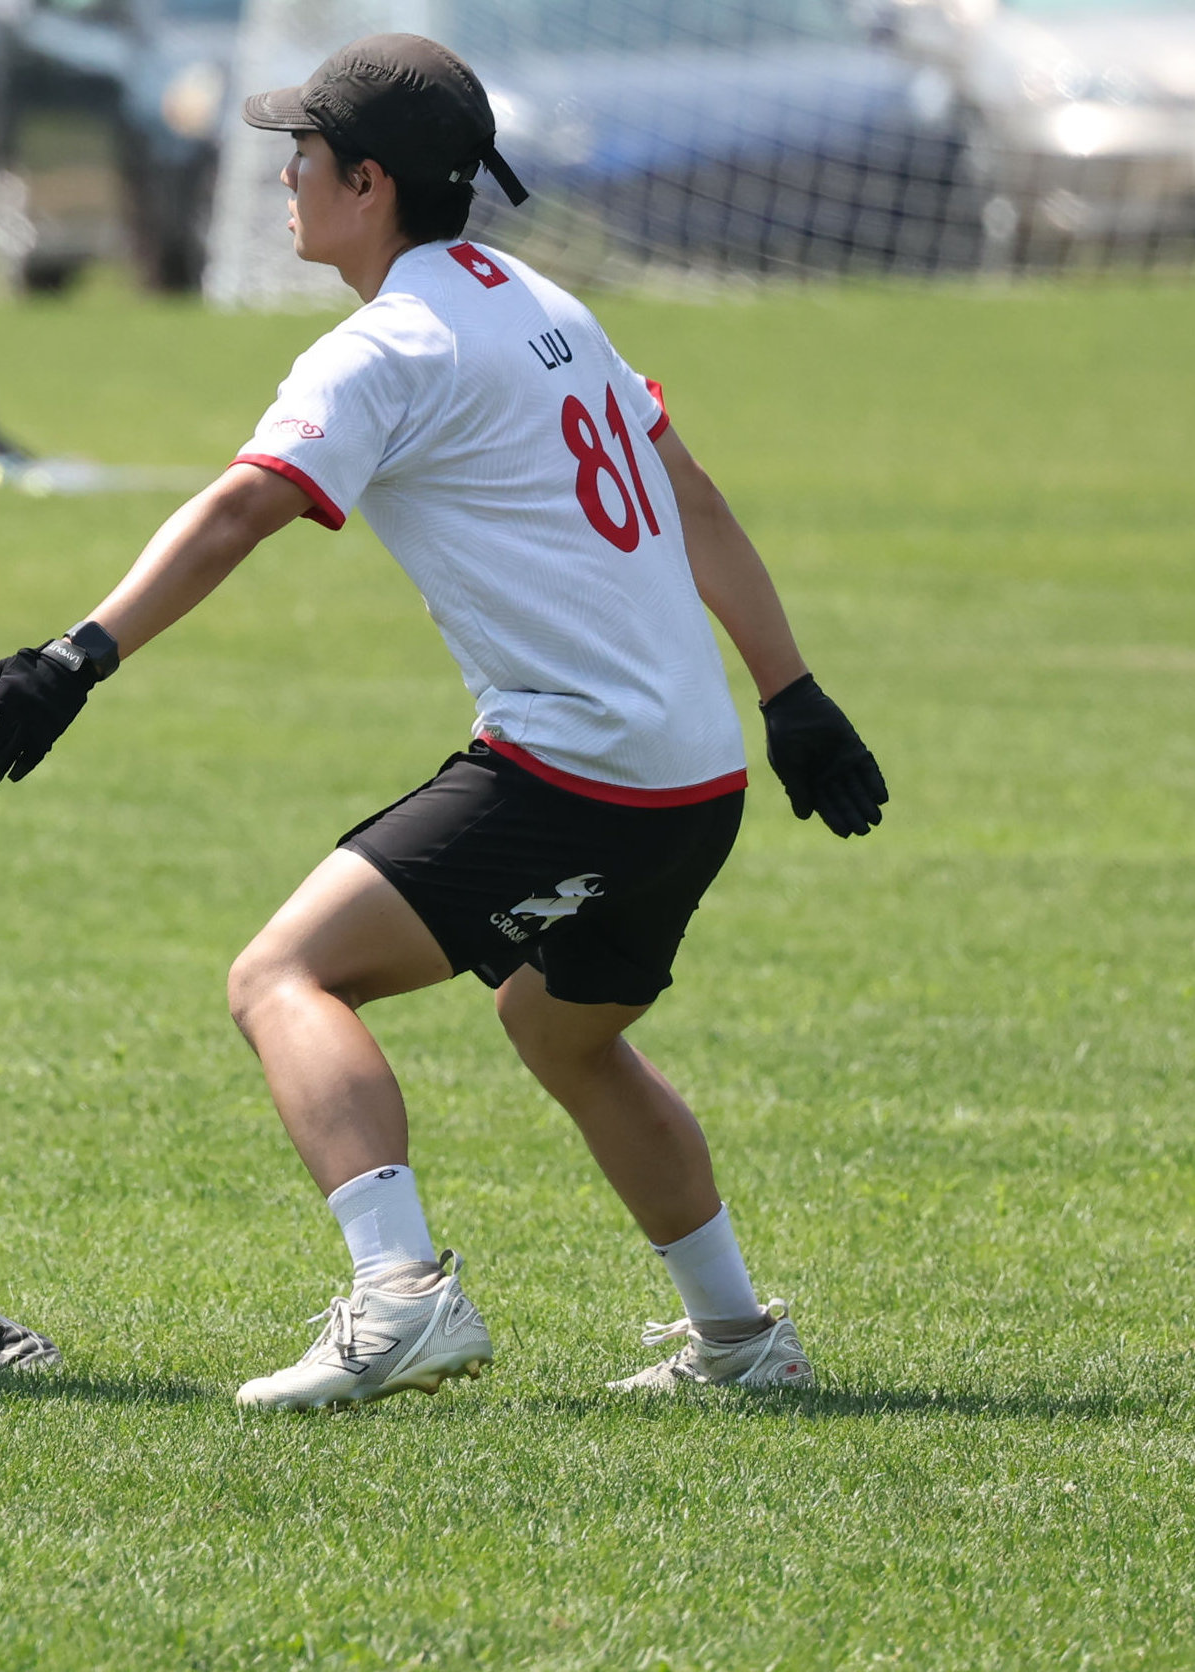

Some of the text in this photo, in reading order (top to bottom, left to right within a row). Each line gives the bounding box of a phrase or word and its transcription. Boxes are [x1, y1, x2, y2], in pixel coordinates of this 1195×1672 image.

[528, 328, 573, 371] LIU
[561, 381, 661, 553] 81
[48, 644, 80, 663] LAYOUT
